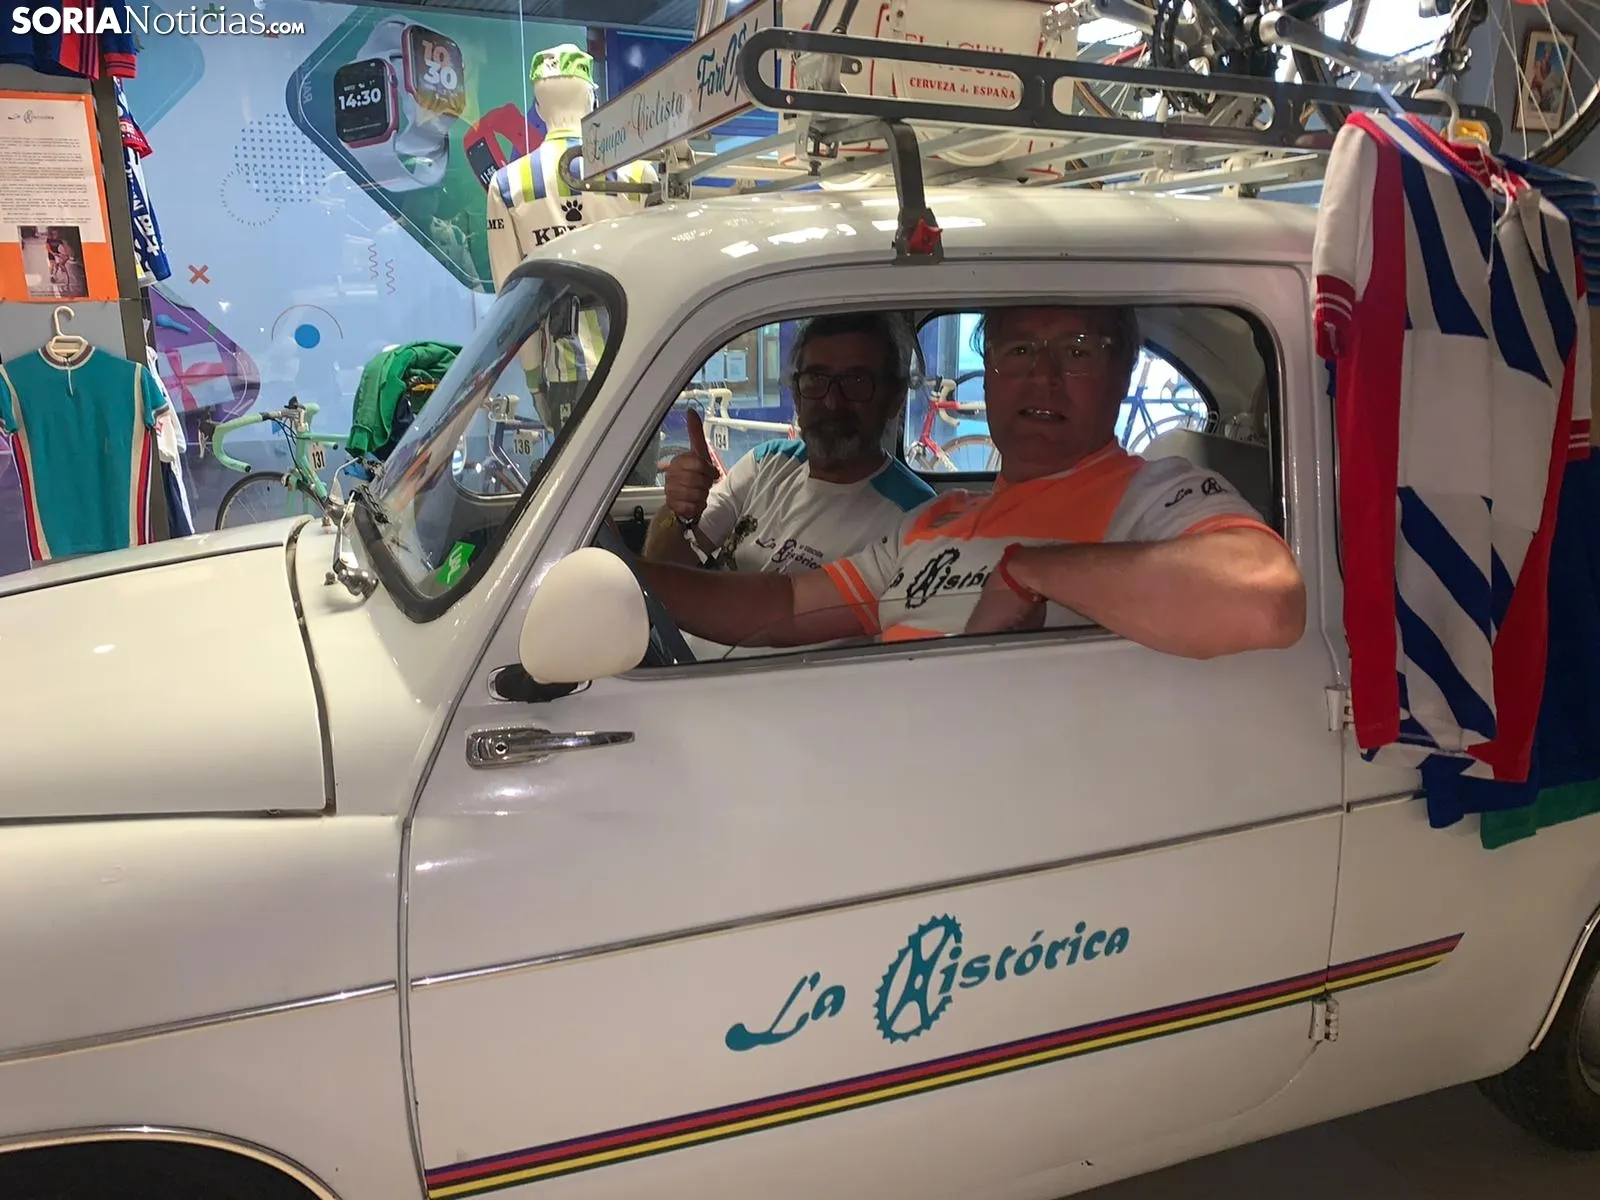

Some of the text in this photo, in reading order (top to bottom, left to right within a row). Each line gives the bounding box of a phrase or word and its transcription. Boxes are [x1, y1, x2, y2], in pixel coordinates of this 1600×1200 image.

[422, 40, 449, 69] 10
[423, 60, 457, 90] 30
[338, 88, 381, 110] 14:30
[909, 77, 956, 92] CERVEZA
[973, 85, 1016, 100] ESPAÑA
[514, 440, 530, 455] 136
[312, 450, 325, 469] 131
[755, 538, 776, 549] La
[725, 913, 1130, 1051] La Histórica
